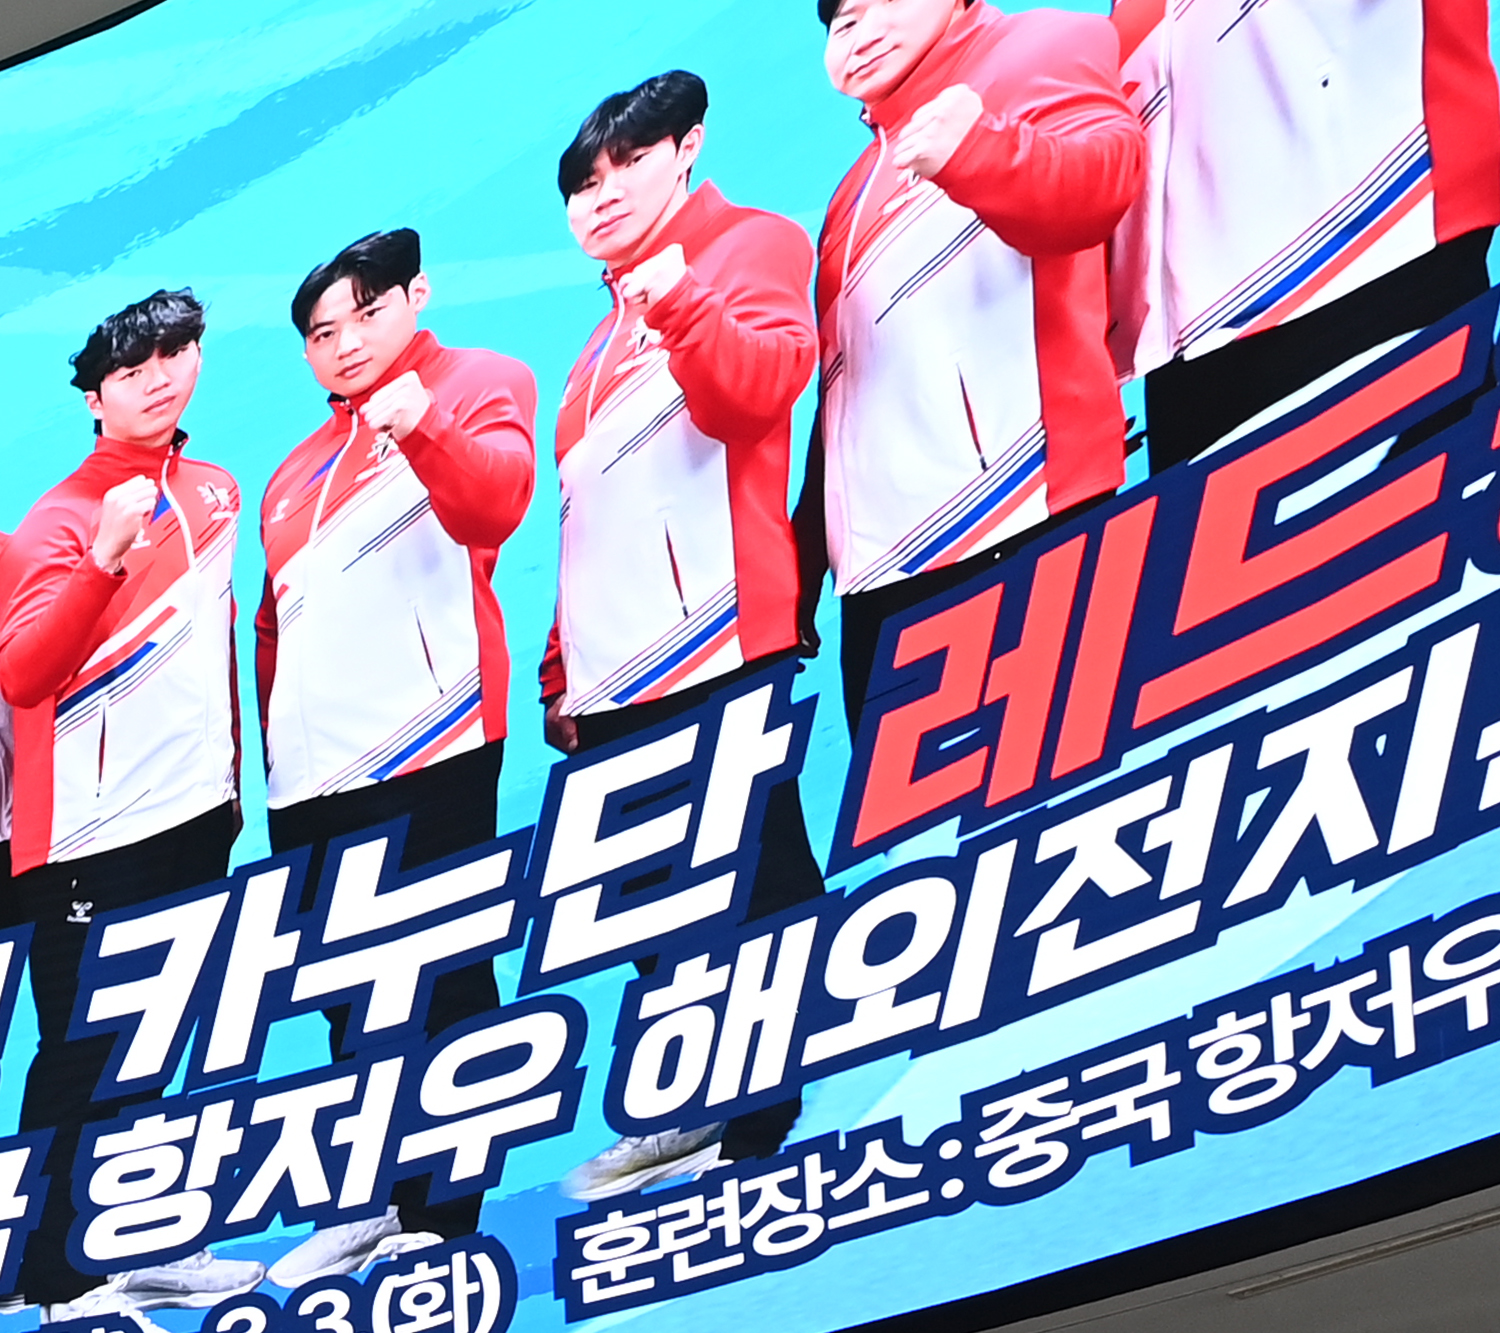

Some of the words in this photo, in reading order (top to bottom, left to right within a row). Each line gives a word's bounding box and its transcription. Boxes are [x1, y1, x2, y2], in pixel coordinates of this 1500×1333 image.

[87, 684, 792, 1081] 카누단
[84, 1013, 566, 1259] 항저우
[976, 1043, 1180, 1187] 중국
